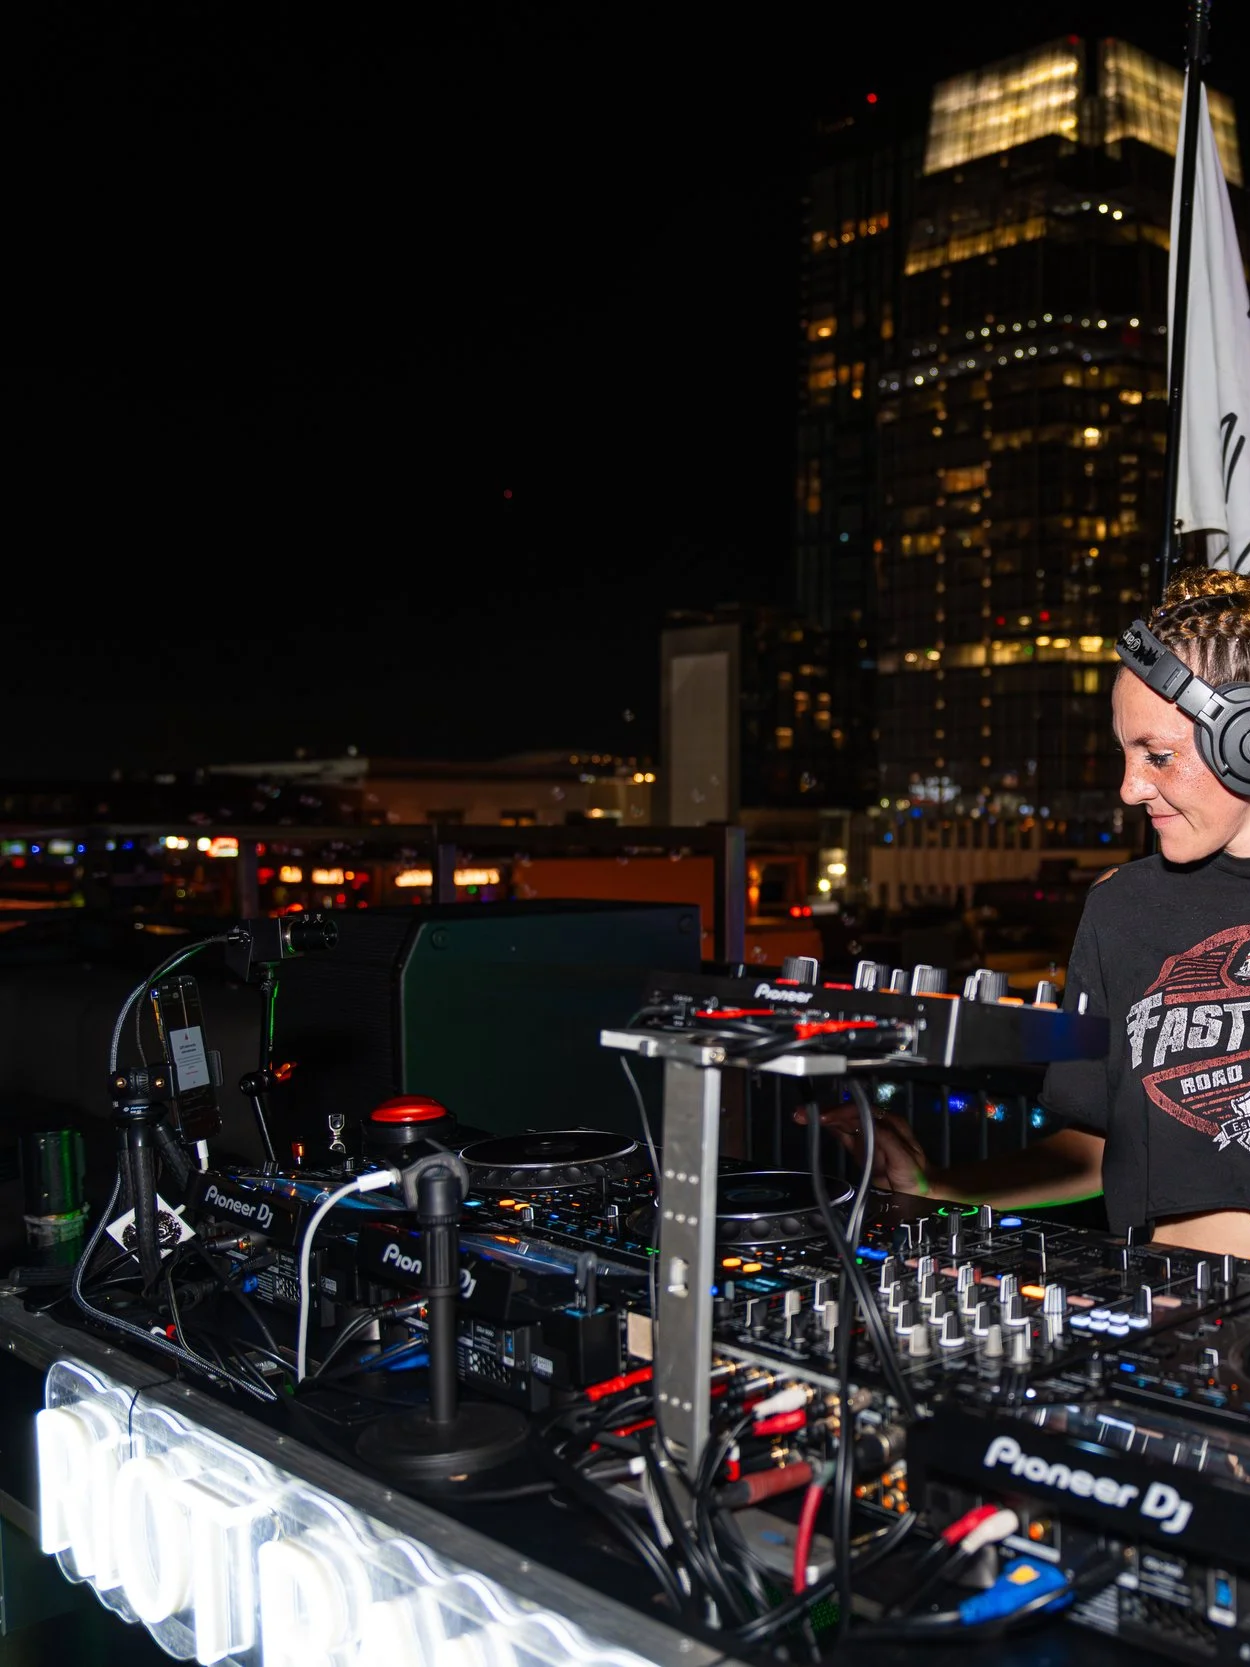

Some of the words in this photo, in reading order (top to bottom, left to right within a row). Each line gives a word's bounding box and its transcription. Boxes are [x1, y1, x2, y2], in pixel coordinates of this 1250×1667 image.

[754, 983, 813, 1004] Pioneer
[1180, 1063, 1243, 1095] ROAD
[204, 1185, 256, 1217] Pioneer
[382, 1243, 423, 1275] Pion
[984, 1436, 1139, 1508] Pioneer
